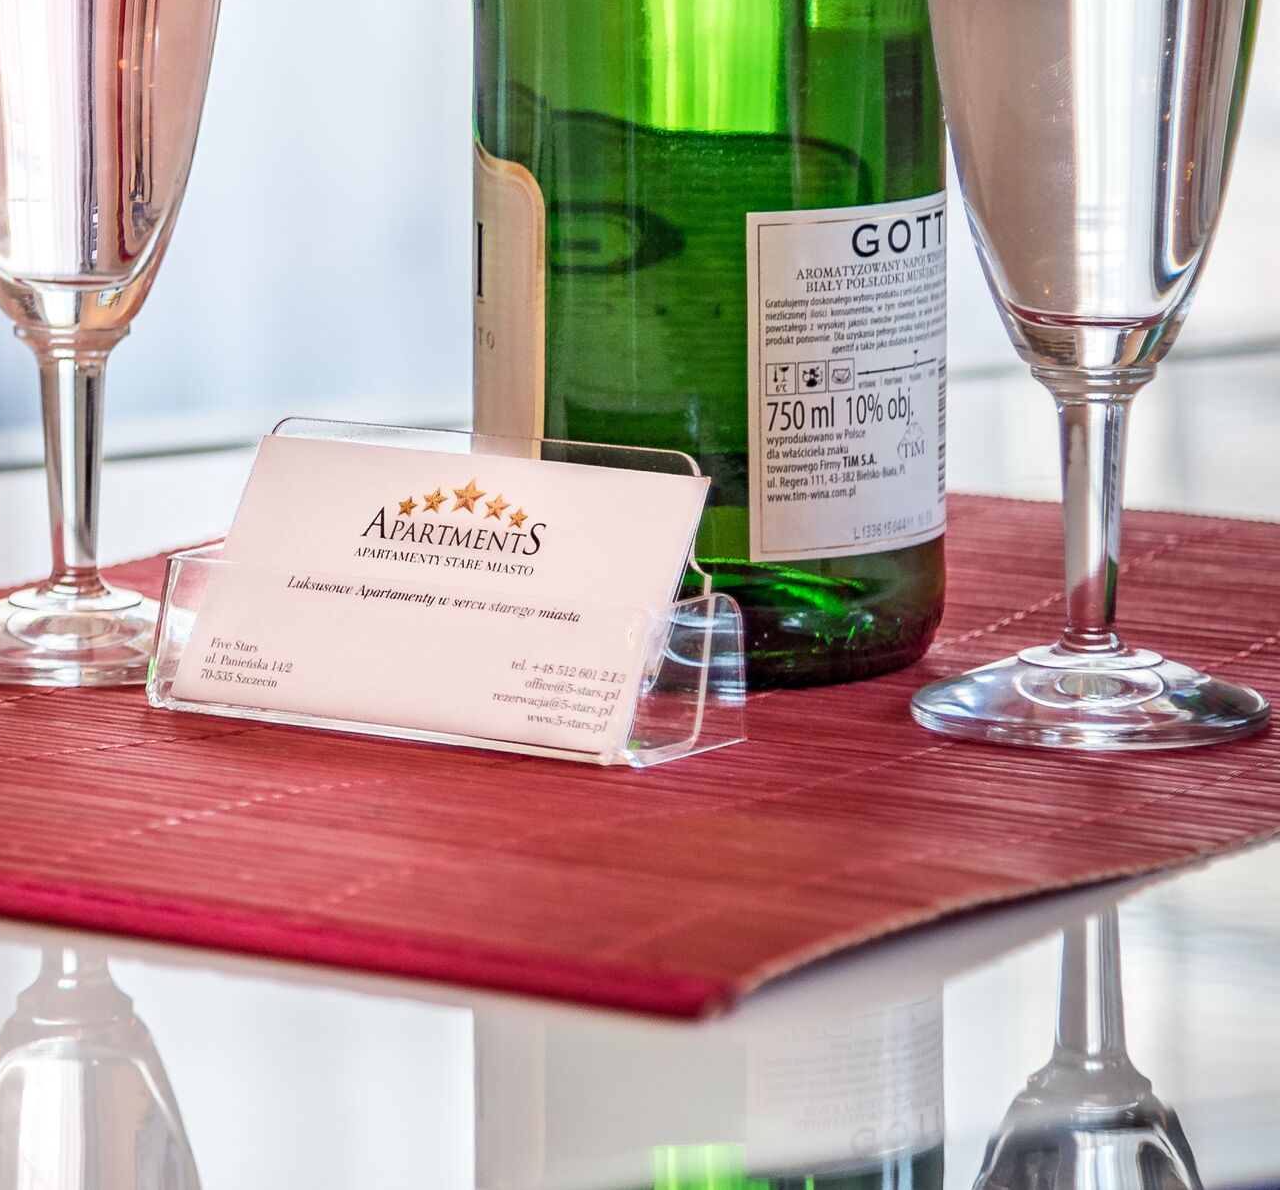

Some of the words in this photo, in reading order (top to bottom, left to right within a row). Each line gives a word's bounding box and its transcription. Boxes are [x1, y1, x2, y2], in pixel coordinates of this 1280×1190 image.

[851, 210, 944, 258] GOTT
[796, 259, 901, 281] AROMATYZOWANY
[806, 279, 844, 293] BIAŁY
[766, 335, 794, 348] produkt
[766, 400, 805, 432] 750
[810, 396, 835, 430] ml
[846, 391, 884, 426] 10%
[887, 387, 915, 426] obj.
[766, 431, 834, 448] wyprodukowano
[836, 432, 842, 440] w
[844, 428, 866, 440] Polsce
[766, 449, 780, 460] dla
[782, 446, 826, 459] właściciela
[826, 444, 849, 456] znaku
[766, 462, 819, 476] towarowego
[820, 460, 842, 472] Firmy
[860, 453, 878, 467] S.A.
[766, 478, 778, 489] ul.
[780, 476, 808, 491] Regera
[811, 474, 828, 488] 111,
[828, 472, 856, 486] 43-382
[766, 485, 856, 503] www.tim-wina.com.pl
[353, 547, 445, 566] APARTAMENTY
[444, 556, 484, 571] STARE
[485, 561, 535, 577] MIASTO
[286, 575, 354, 596] Luksusowe
[354, 584, 436, 608] Apartamenty
[438, 595, 450, 607] w
[452, 597, 487, 612] sercu
[488, 601, 536, 618] starego
[537, 606, 582, 624] miasta
[210, 637, 232, 650] Five
[234, 640, 258, 653] Stars
[205, 652, 217, 664] ul.
[220, 654, 268, 671] Panieńska
[271, 660, 293, 674] 14/2
[511, 659, 527, 671] tel.
[532, 662, 554, 675] +48
[556, 665, 577, 678] 512
[578, 668, 599, 681] 601
[200, 668, 234, 683] 70-535
[234, 672, 278, 688] Szczecin
[524, 678, 622, 702] office@5-stars.pl
[492, 691, 615, 717] rezerwacja@5-stars.pl
[527, 712, 608, 734] www.5-stars.pl
